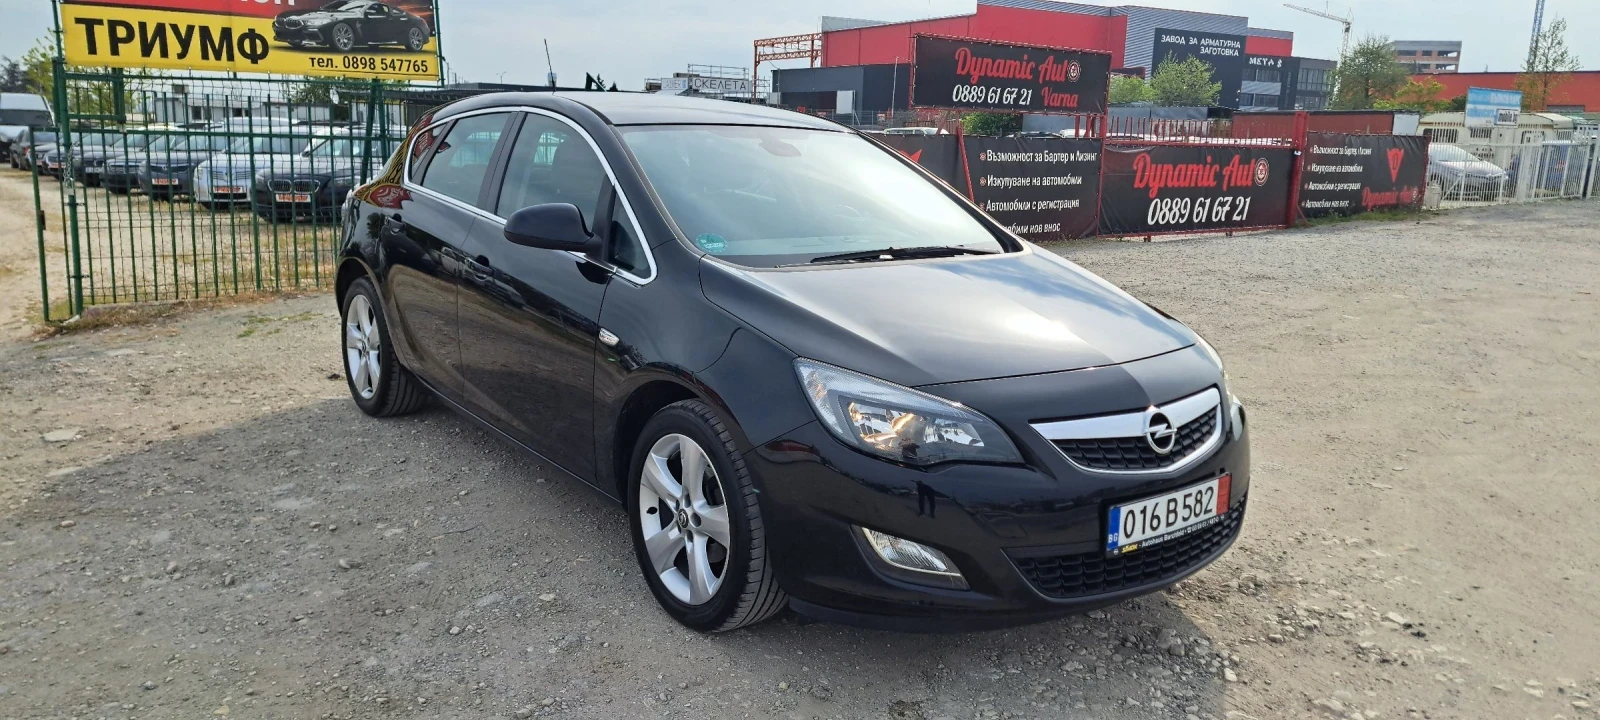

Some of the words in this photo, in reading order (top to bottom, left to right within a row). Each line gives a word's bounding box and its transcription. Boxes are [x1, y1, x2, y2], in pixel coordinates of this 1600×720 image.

[75, 17, 269, 64] ТРИУМФ
[1161, 35, 1186, 45] ЗАВОД
[1189, 37, 1198, 45] ЗА
[1200, 38, 1241, 49] АРМАТУРНА
[1200, 46, 1239, 57] ЗАГОТОВКА
[309, 57, 338, 69] тел.
[343, 55, 376, 71] 0898
[380, 58, 428, 73] 547765
[955, 47, 1036, 85] Dynamic
[694, 78, 747, 90] СКЕЛЕТА
[952, 84, 986, 103] 0889
[987, 86, 1002, 104] 61
[1002, 87, 1019, 105] 67
[1018, 88, 1033, 106] 21
[1041, 86, 1079, 107] Varna
[986, 149, 1033, 162] Възможност
[1034, 153, 1043, 162] за
[1043, 150, 1069, 164] Бартер
[987, 174, 1031, 189] Изкупуване
[1031, 177, 1041, 186] на
[1042, 173, 1082, 186] автомобили
[1132, 152, 1220, 199] Dynamic
[986, 198, 1031, 212] Автомобили
[1037, 199, 1080, 212] регистрация
[1147, 198, 1191, 225] 0889
[1192, 197, 1212, 223] 61
[1211, 196, 1234, 222] 67
[1232, 196, 1252, 221] 21
[1029, 223, 1043, 234] нов
[1043, 222, 1061, 233] внос
[1108, 533, 1119, 543] BG
